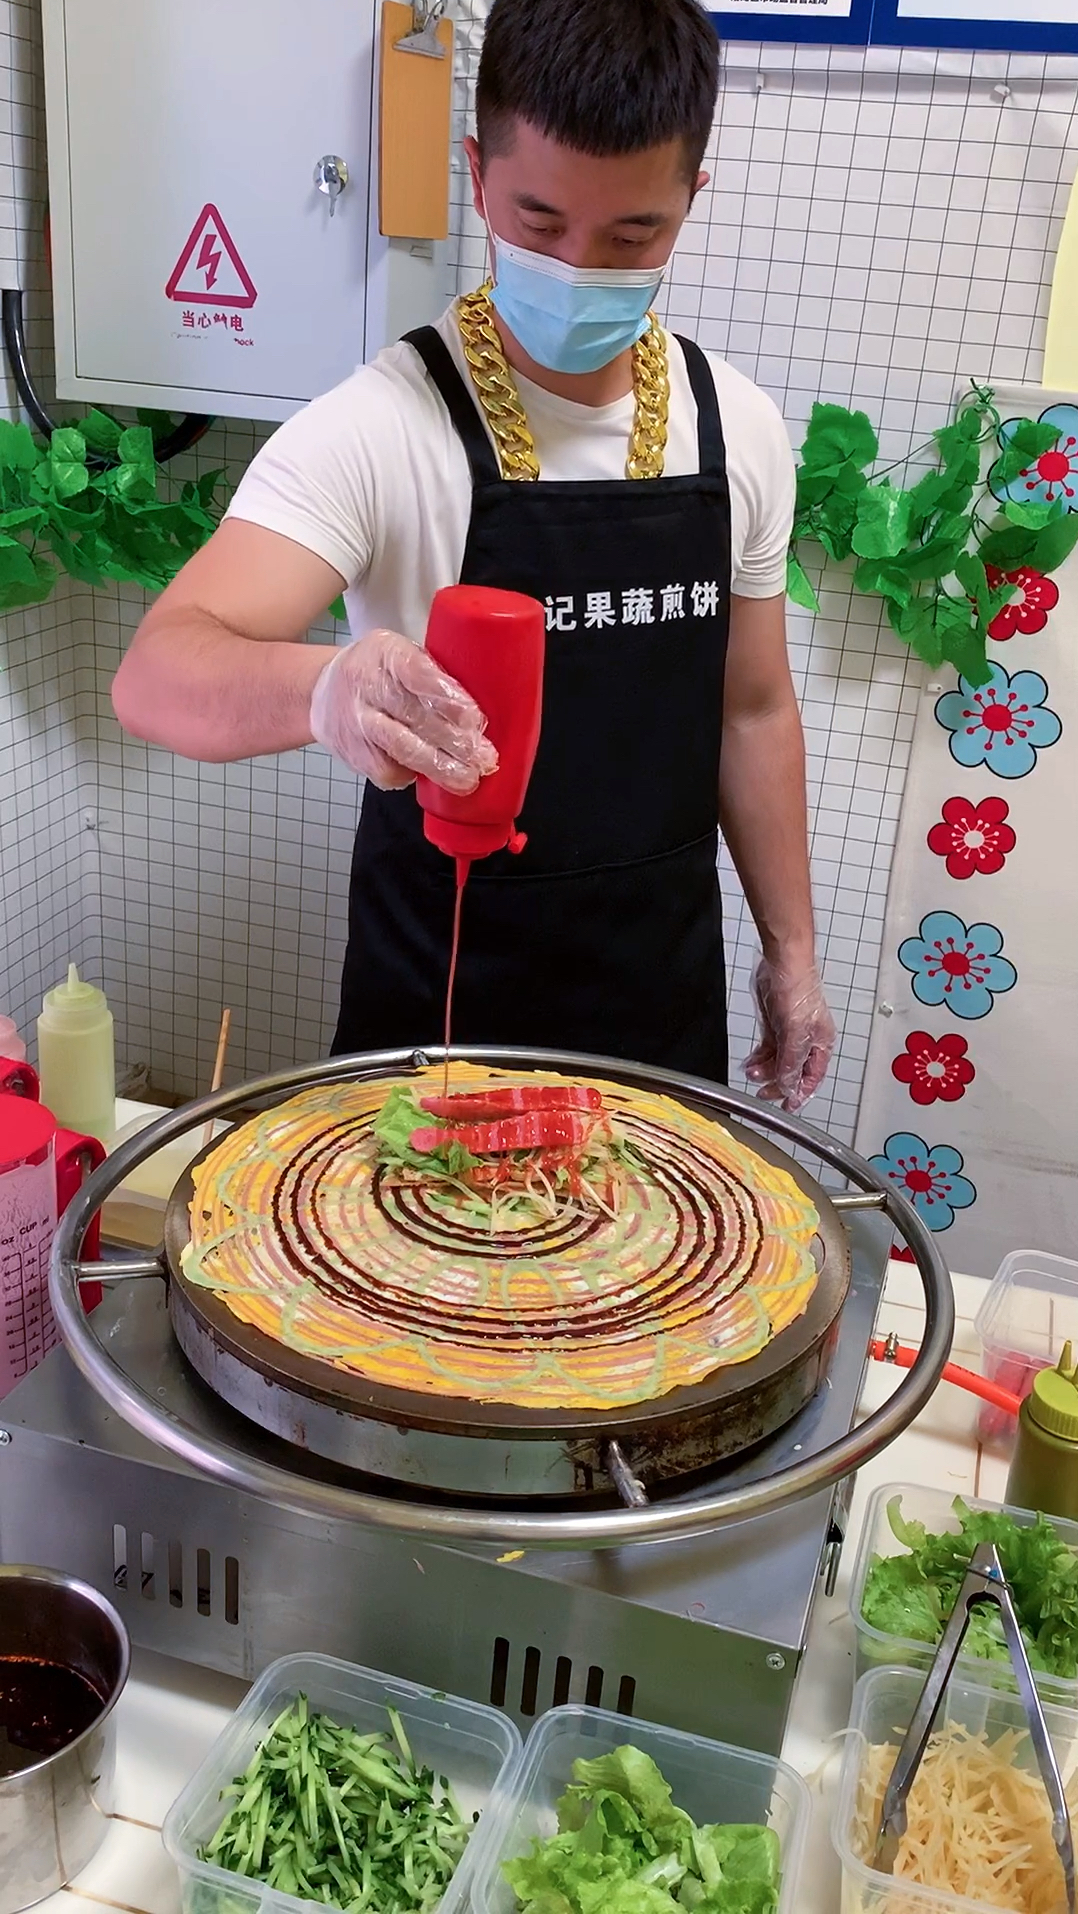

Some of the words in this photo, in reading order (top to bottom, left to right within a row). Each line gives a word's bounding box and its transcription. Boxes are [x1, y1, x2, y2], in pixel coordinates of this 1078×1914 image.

[544, 581, 719, 631] 记果蔬煎饼
[19, 1221, 37, 1235] CUP
